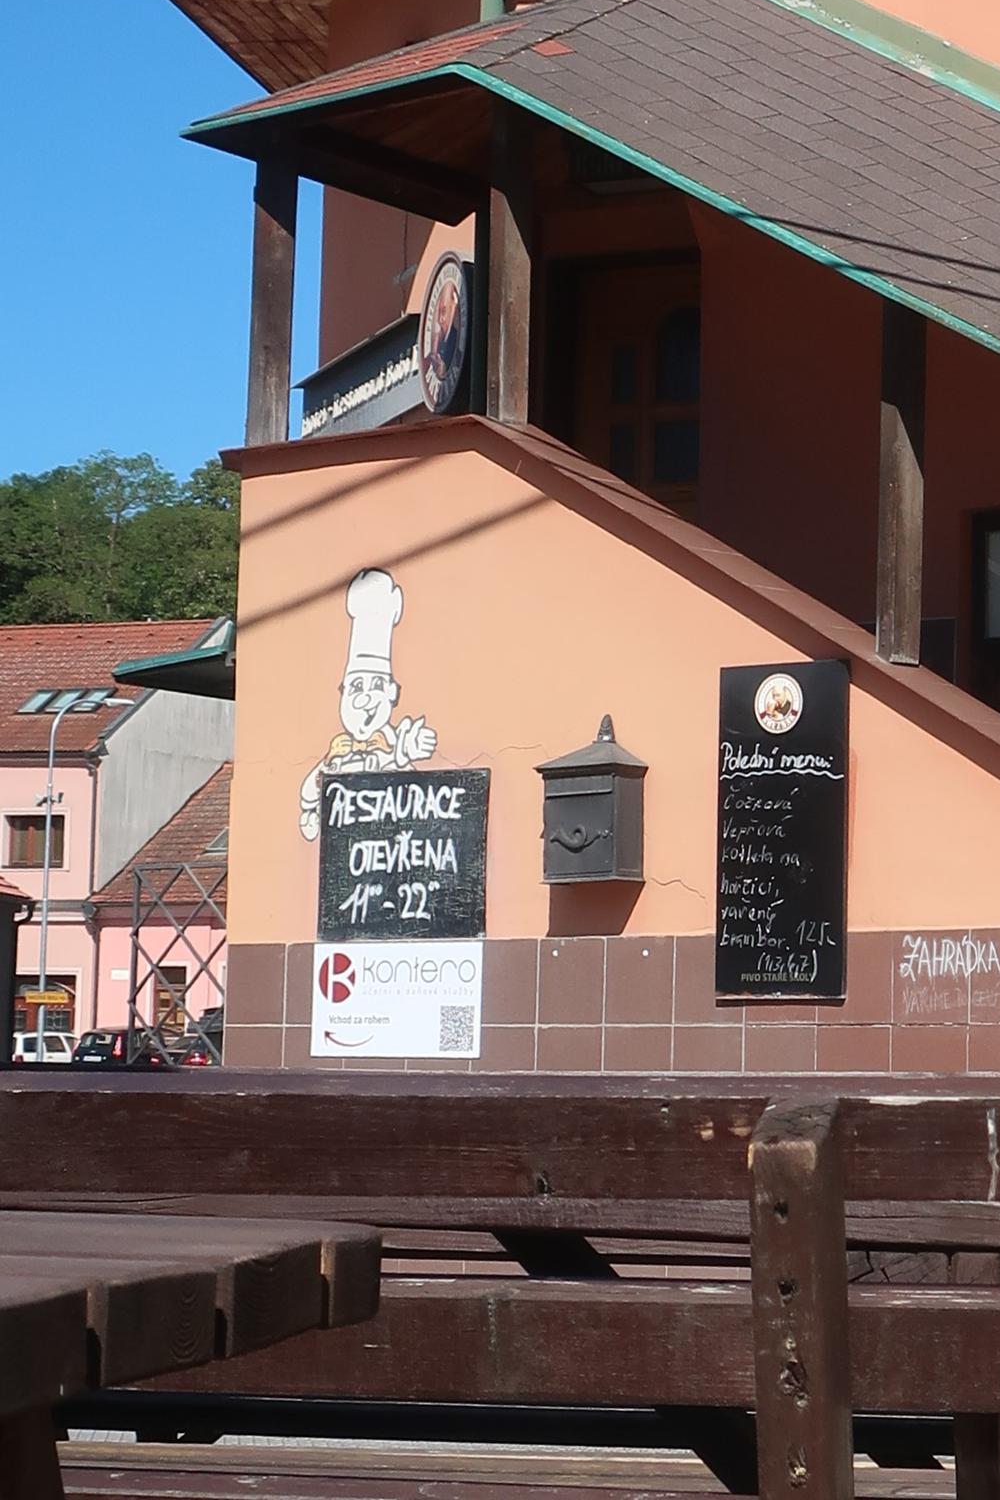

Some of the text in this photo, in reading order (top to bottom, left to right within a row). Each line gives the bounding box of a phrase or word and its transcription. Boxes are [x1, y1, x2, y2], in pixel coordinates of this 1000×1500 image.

[720, 742, 779, 772] Polední
[325, 782, 466, 828] RESTAURACE
[350, 830, 458, 876] OTEVŘENA
[362, 956, 477, 984] kontero
[740, 973, 762, 982] PIVO
[328, 1015, 352, 1025] Vchod
[364, 1015, 390, 1025] rohem
